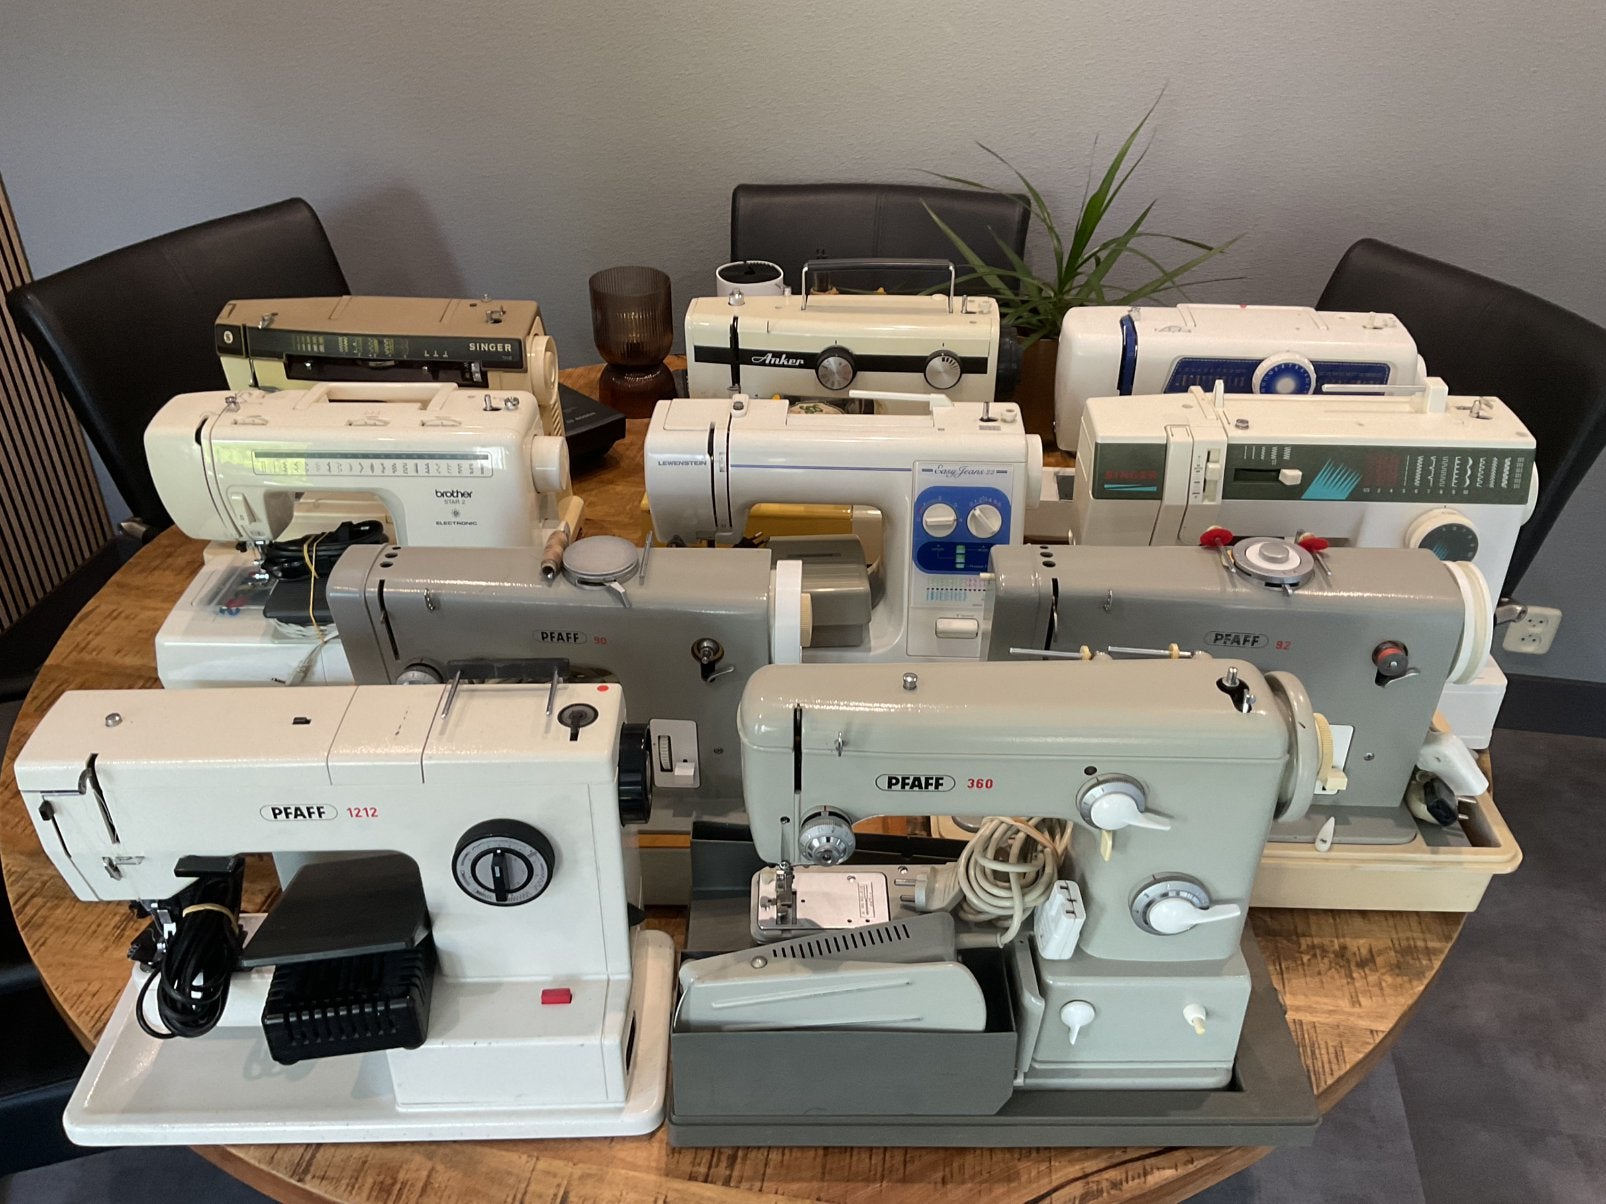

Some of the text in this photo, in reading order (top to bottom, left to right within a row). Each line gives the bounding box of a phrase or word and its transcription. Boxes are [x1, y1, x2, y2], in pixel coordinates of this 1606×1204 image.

[469, 342, 512, 352] SINGER
[751, 352, 805, 366] Anker
[934, 464, 956, 478] Easy
[953, 465, 984, 479] Jeans
[434, 489, 473, 499] brother
[541, 631, 580, 643] PFAFF
[1213, 633, 1292, 650] PFAFF 92
[887, 775, 994, 790] PFAFF 360
[271, 805, 379, 820] PFAFF 1212
